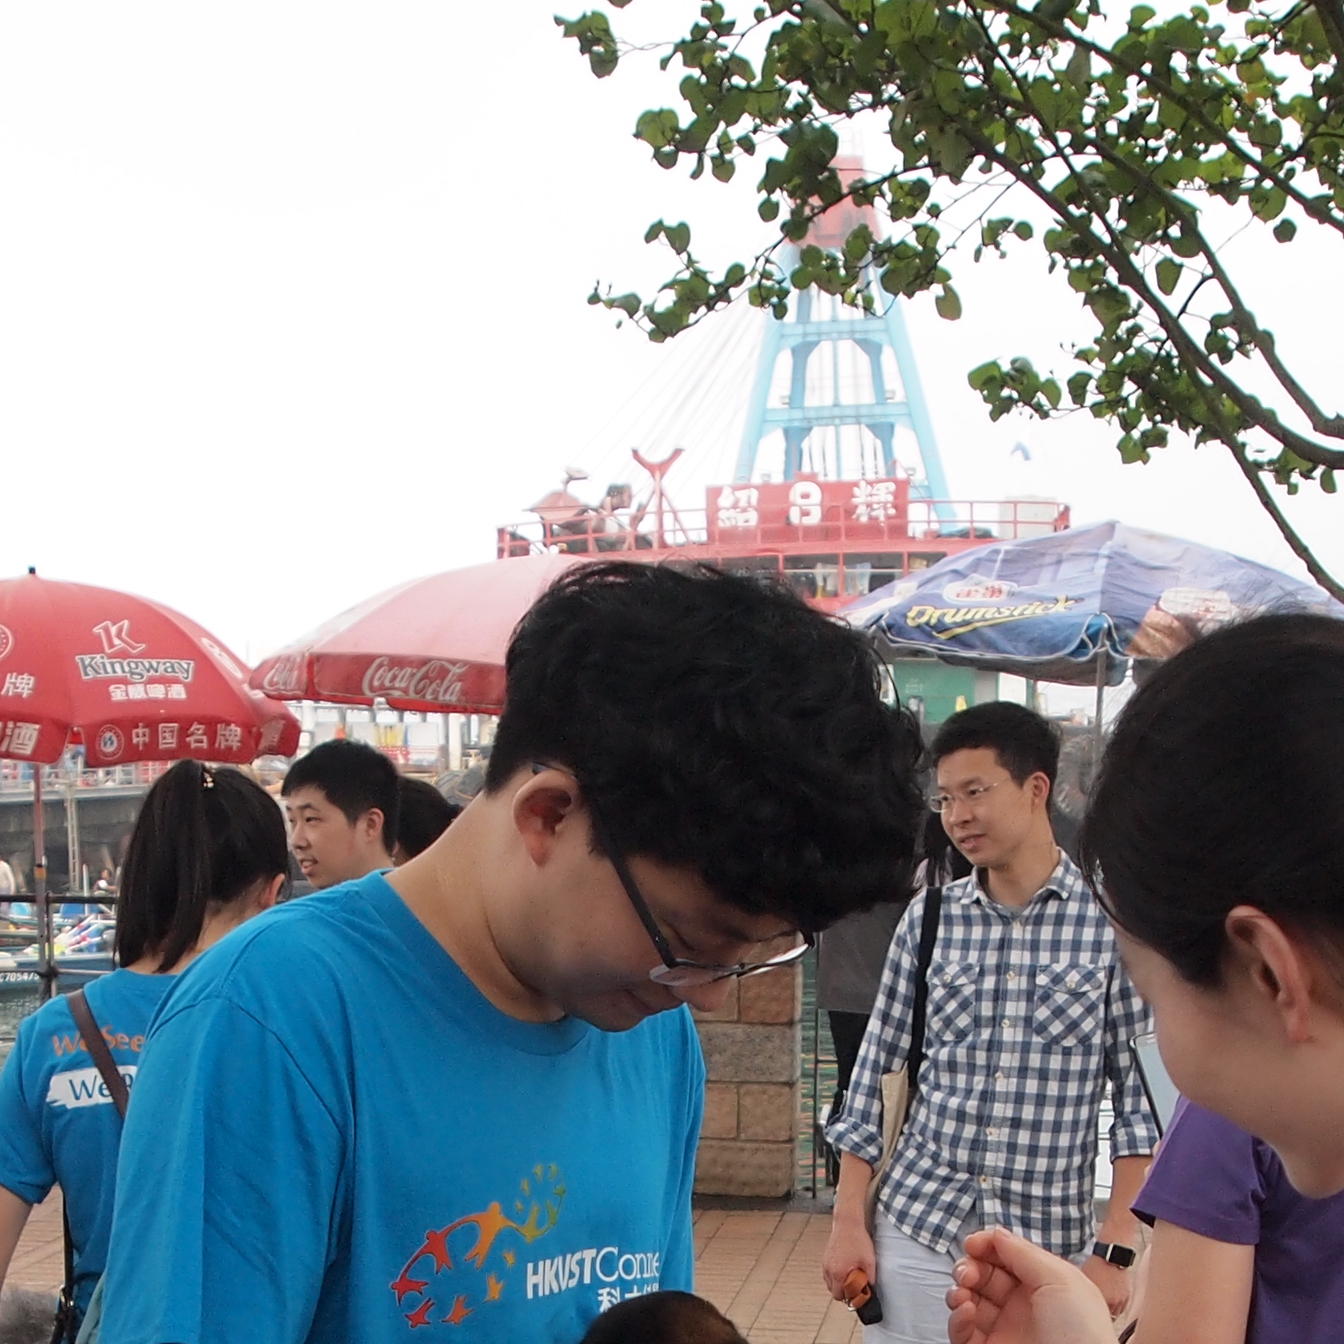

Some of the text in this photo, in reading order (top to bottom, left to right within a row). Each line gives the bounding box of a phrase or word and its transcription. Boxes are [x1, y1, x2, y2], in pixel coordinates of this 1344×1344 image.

[906, 594, 1080, 628] Drumstick
[76, 655, 195, 682] Kingway
[131, 722, 242, 751] 中国名牌
